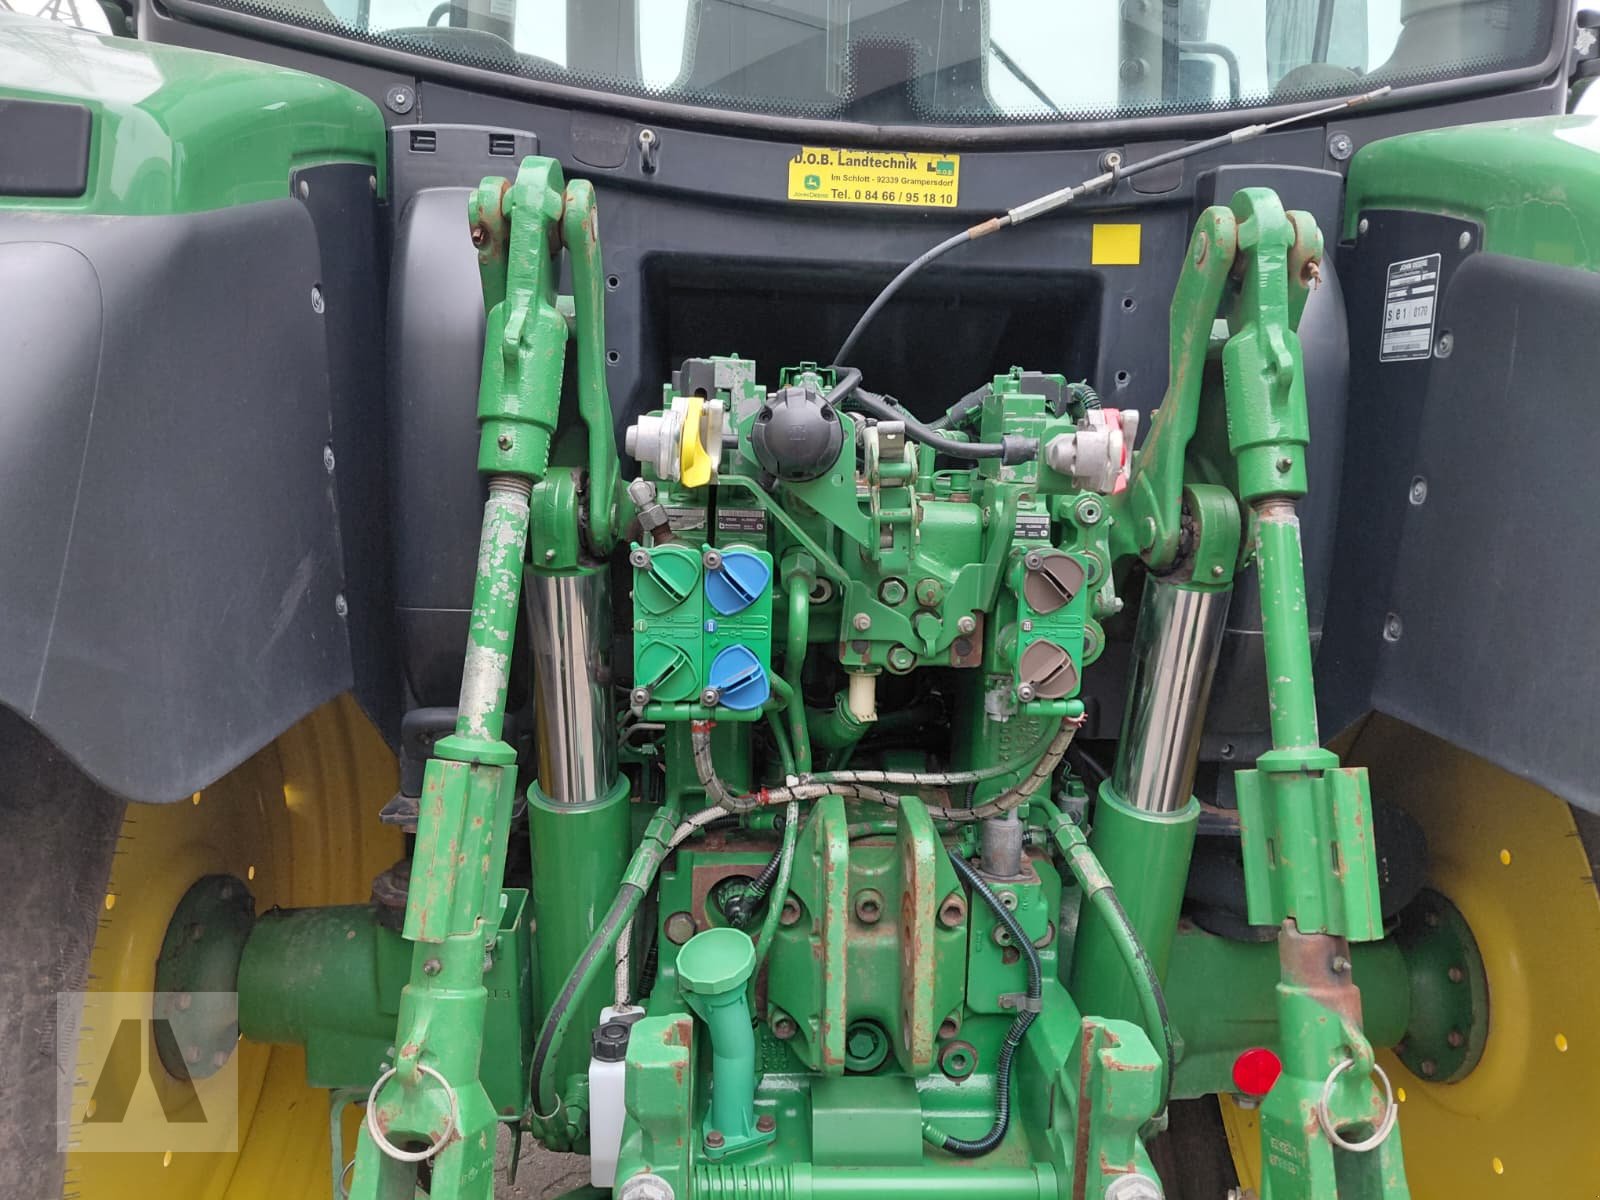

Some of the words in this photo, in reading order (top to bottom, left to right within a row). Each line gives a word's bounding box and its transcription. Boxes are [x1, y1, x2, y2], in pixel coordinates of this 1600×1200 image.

[838, 152, 917, 170] Landtechnik
[843, 175, 870, 183] Schlott
[877, 176, 899, 184] 92339
[901, 177, 954, 187] Grampersdorf
[832, 188, 850, 200] Tel.
[855, 190, 861, 199] 0
[865, 191, 878, 200] 84
[882, 192, 895, 201] 66
[906, 193, 919, 202] 95
[923, 194, 936, 203] 18
[941, 194, 953, 204] 10
